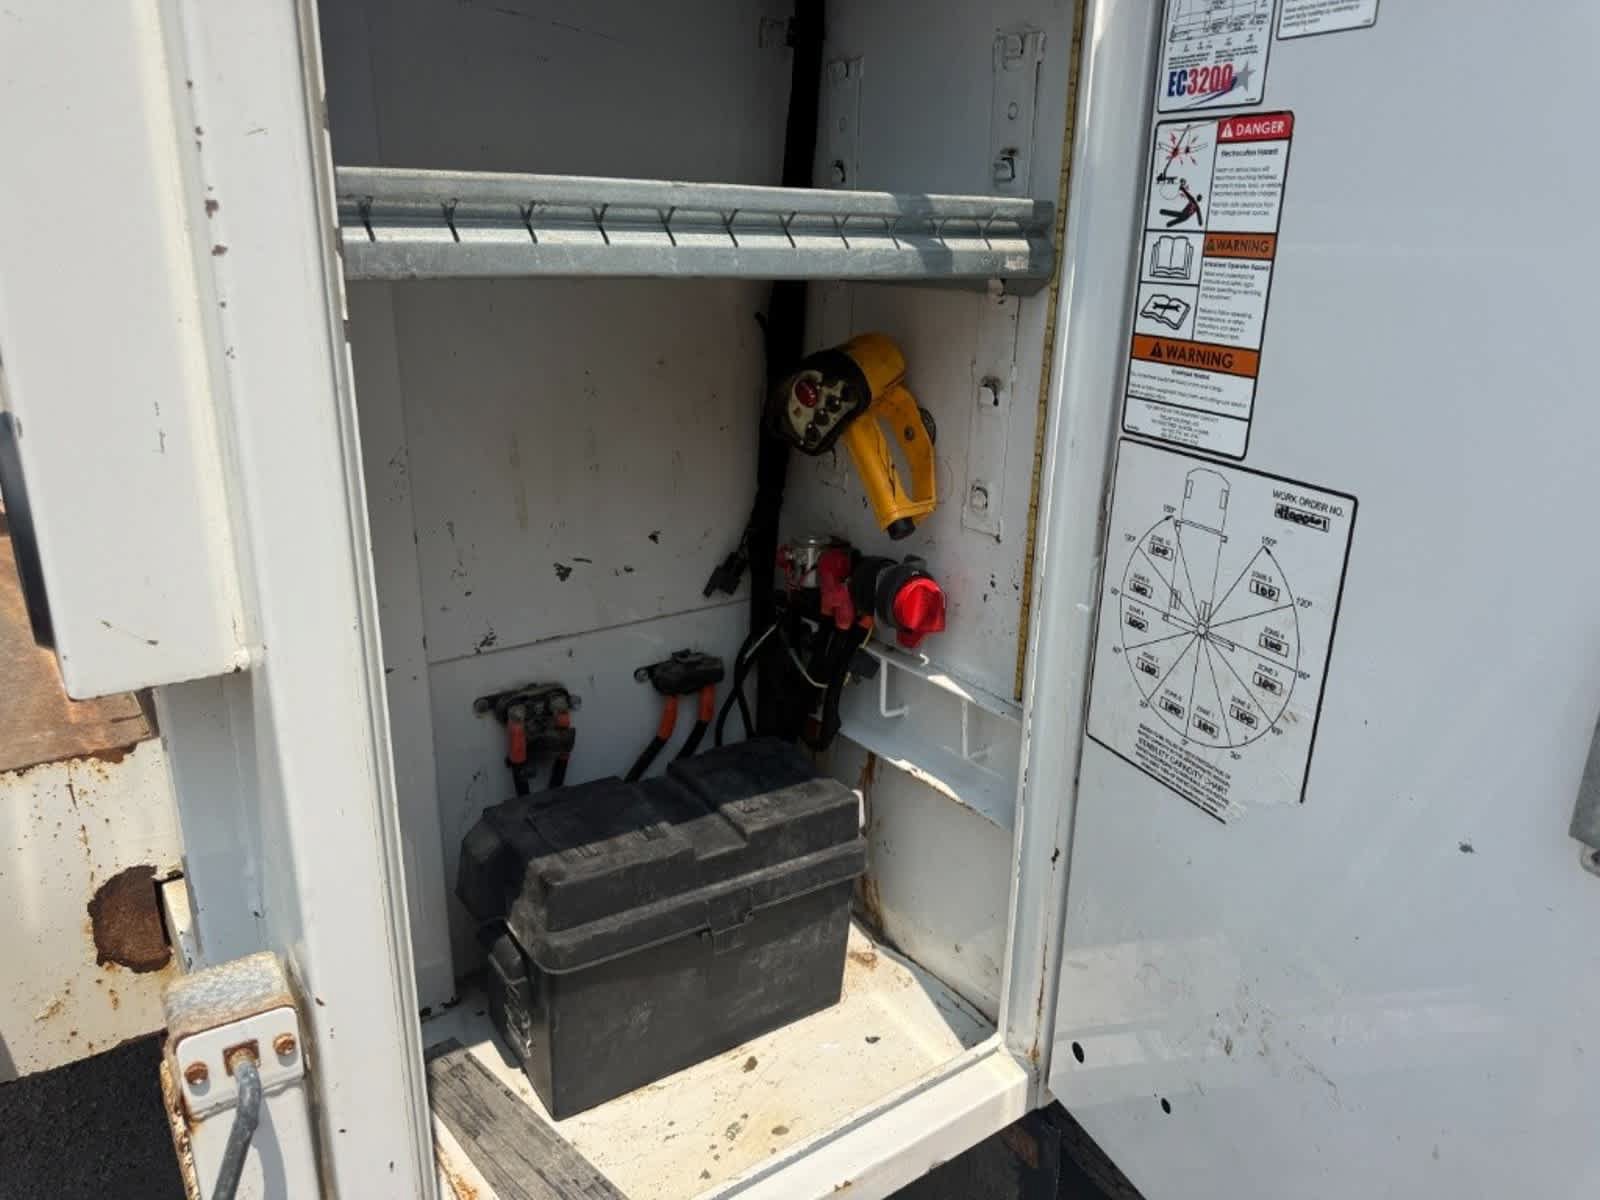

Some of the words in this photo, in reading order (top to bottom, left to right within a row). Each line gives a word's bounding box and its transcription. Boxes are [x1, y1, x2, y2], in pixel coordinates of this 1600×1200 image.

[1168, 64, 1233, 97] EC3200
[1235, 121, 1285, 136] DANGER
[1216, 239, 1269, 253] WARNING
[1166, 344, 1234, 369] WARNING
[1273, 489, 1298, 504] WORK
[1299, 496, 1328, 512] ORDER
[1328, 505, 1344, 518] NO.
[1256, 583, 1276, 598] 100
